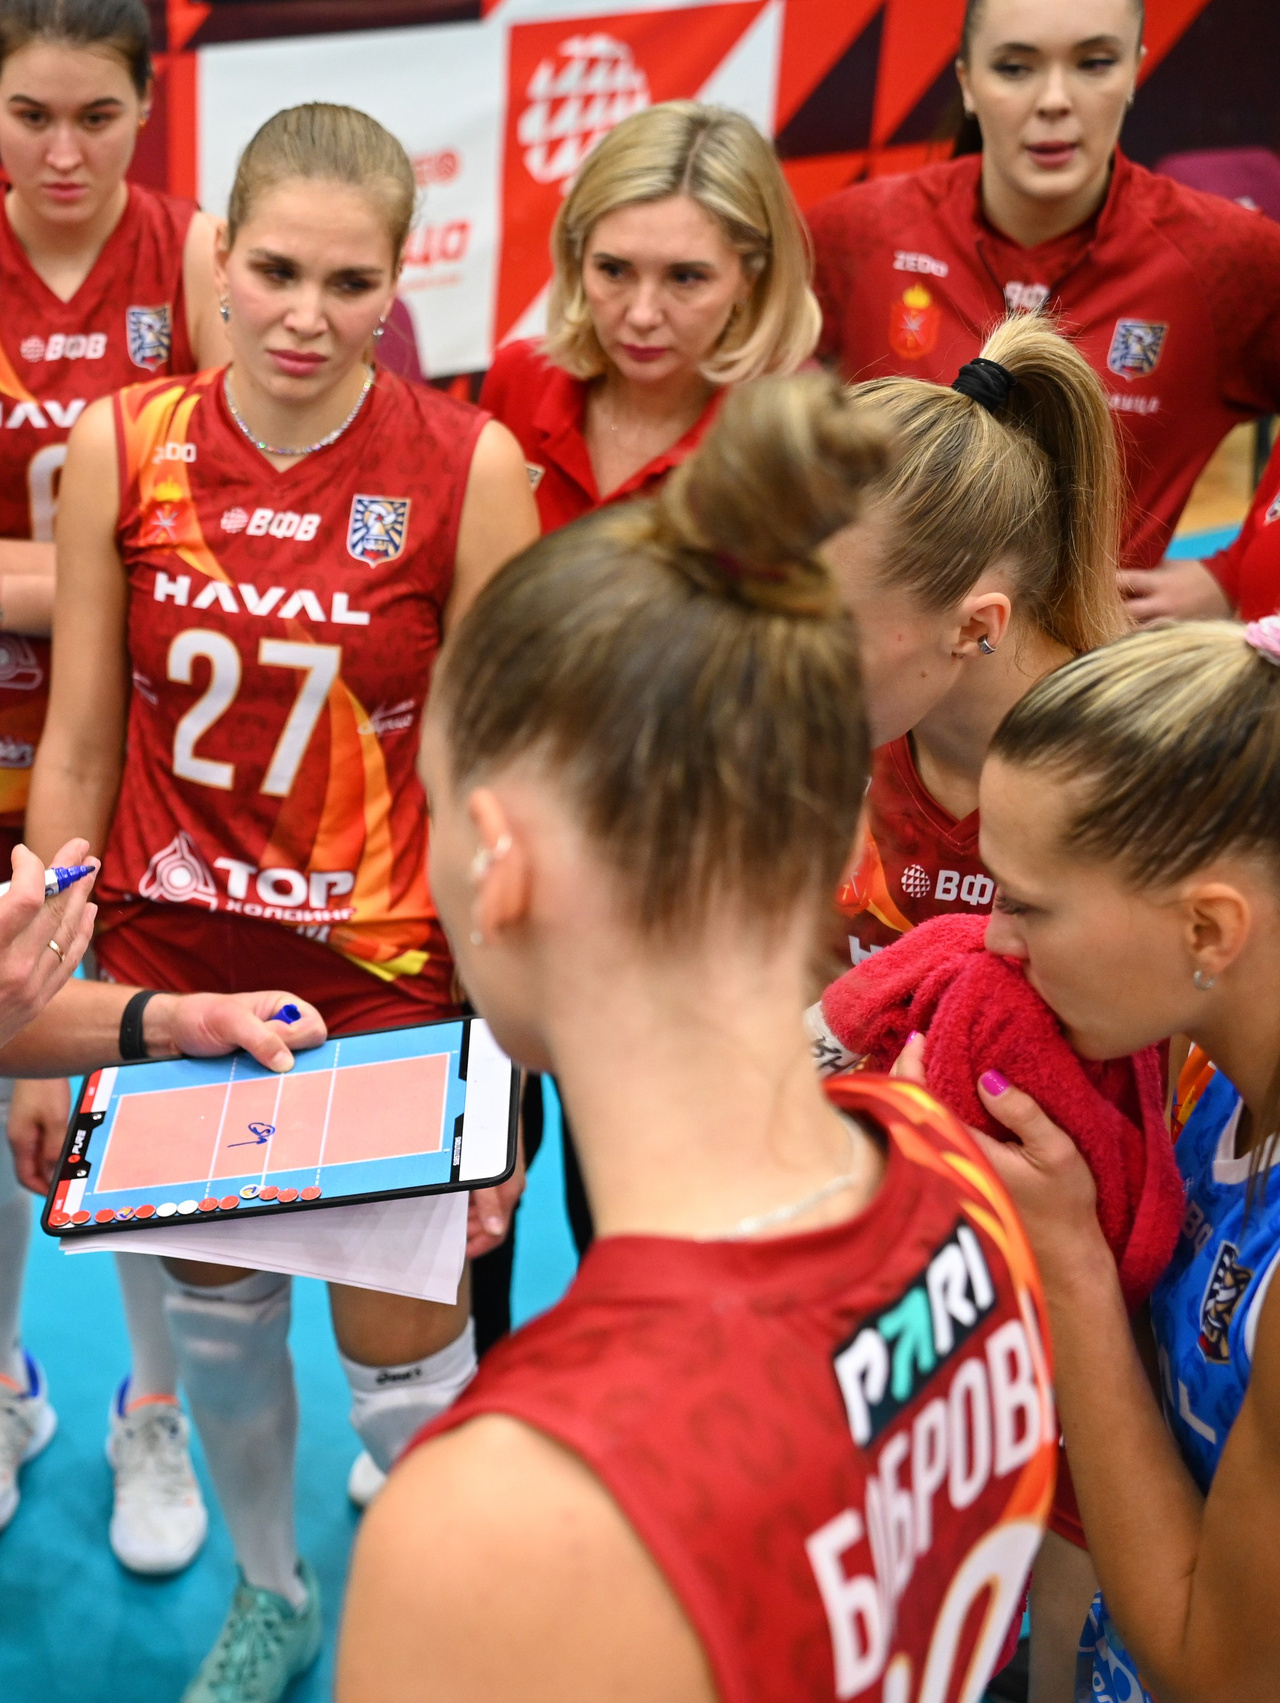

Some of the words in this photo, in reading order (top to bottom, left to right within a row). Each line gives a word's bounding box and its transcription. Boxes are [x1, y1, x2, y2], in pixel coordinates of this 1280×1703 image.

[45, 332, 108, 361] ВФВ
[246, 507, 321, 542] ВФВ
[153, 571, 370, 626] HAVAL
[166, 627, 342, 798] 27
[934, 869, 995, 906] ВФ
[833, 1225, 996, 1448] PARI
